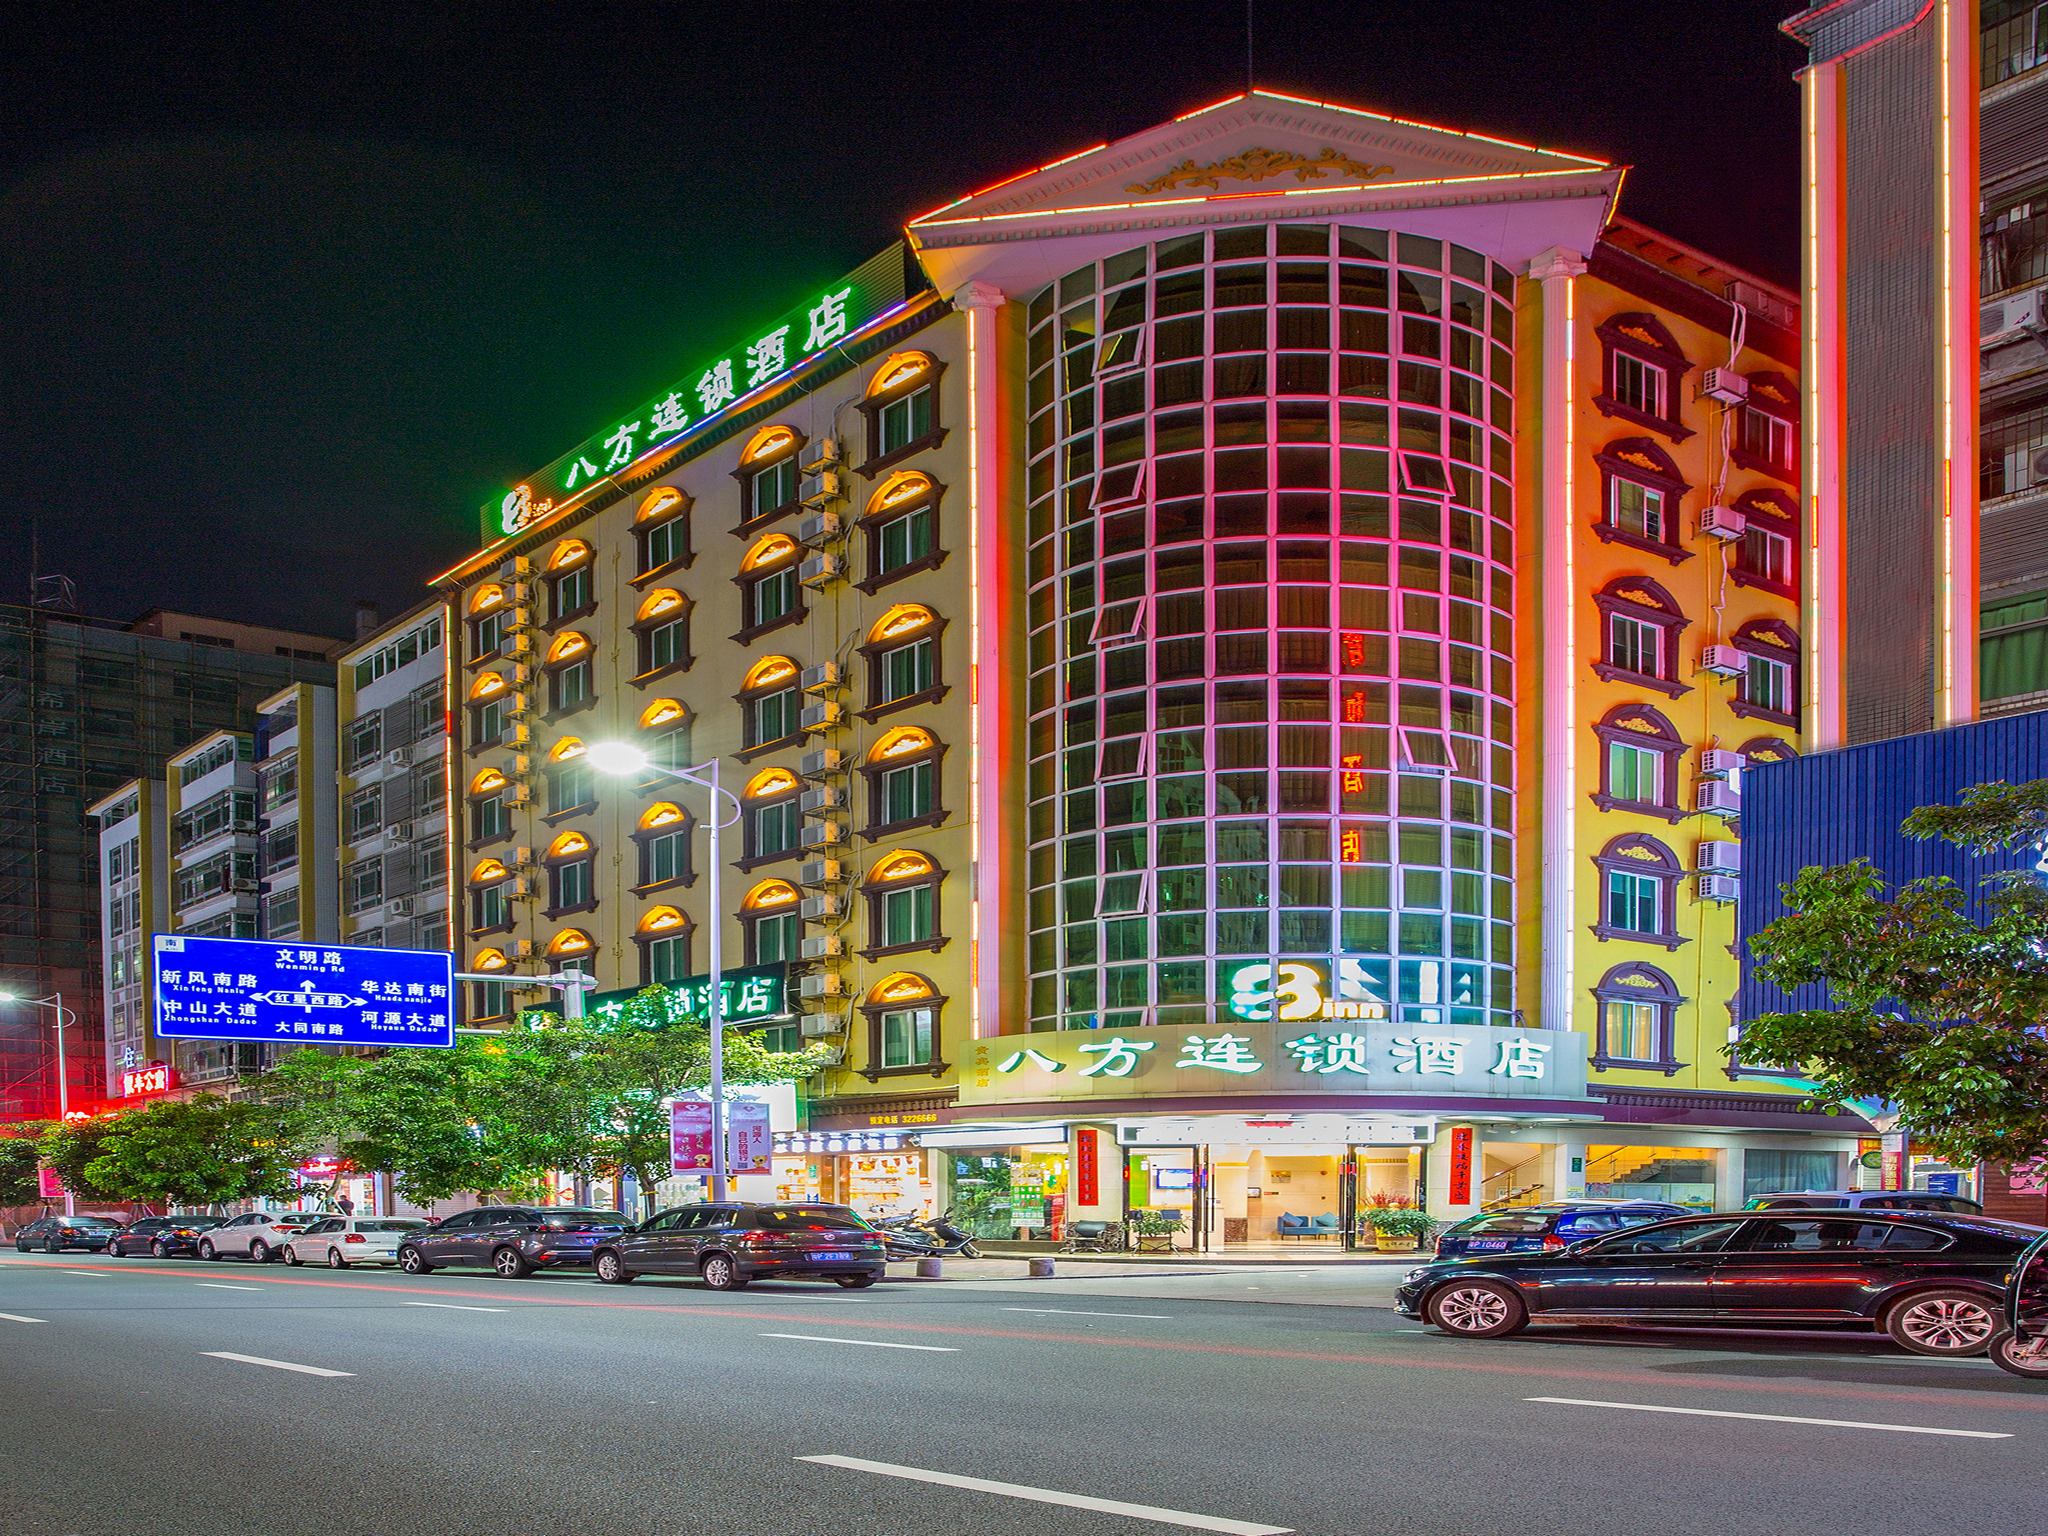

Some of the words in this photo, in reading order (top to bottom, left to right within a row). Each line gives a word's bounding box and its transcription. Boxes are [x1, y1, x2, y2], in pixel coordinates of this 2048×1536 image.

[565, 286, 852, 489] 八方连锁酒店
[37, 690, 68, 795] 希岸酒店
[275, 949, 342, 965] 文明路
[275, 963, 326, 972] Wenming
[331, 965, 345, 973] Rd
[161, 970, 258, 987] 新风南路
[361, 979, 447, 998] 华达南街
[163, 1000, 258, 1016] 中山大道
[274, 993, 344, 1007] 红星西路
[1322, 998, 1384, 1019] inn
[164, 1014, 220, 1024] Zhongshan
[226, 1017, 258, 1025] Dadao
[360, 1010, 447, 1027] 河源大道
[275, 1021, 344, 1036] 大同南路
[409, 1025, 439, 1033] Dadao
[997, 1033, 1552, 1079] 八方连锁酒店
